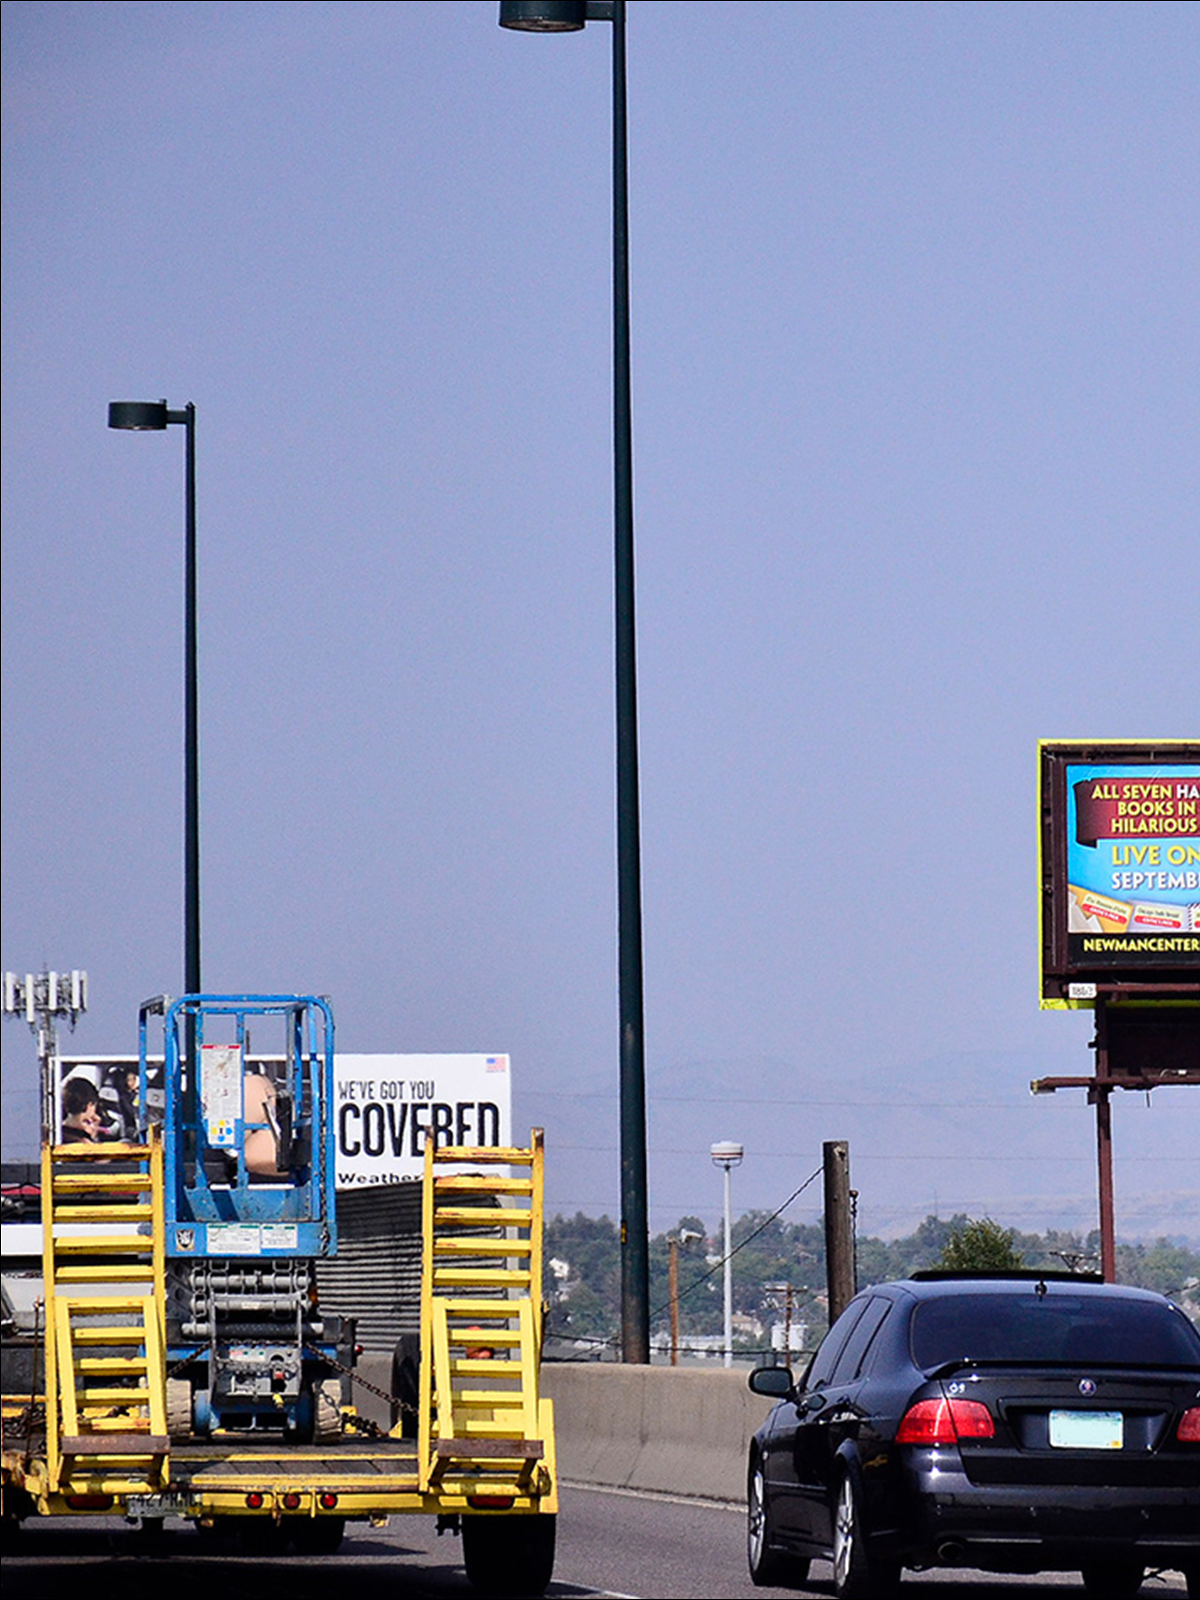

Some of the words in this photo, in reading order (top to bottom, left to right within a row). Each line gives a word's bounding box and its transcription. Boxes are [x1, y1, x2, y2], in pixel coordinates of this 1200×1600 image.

[1092, 785, 1119, 799] ALL
[1123, 784, 1172, 799] SEVEN
[1118, 801, 1174, 815] BOOKS
[1178, 802, 1196, 815] IN
[1111, 818, 1197, 833] HILARIOUS
[1112, 845, 1161, 865] LIVE
[338, 1081, 374, 1100] WE'VE
[380, 1081, 404, 1100] GOT
[410, 1081, 435, 1100] YOU
[338, 1102, 499, 1157] COVERED
